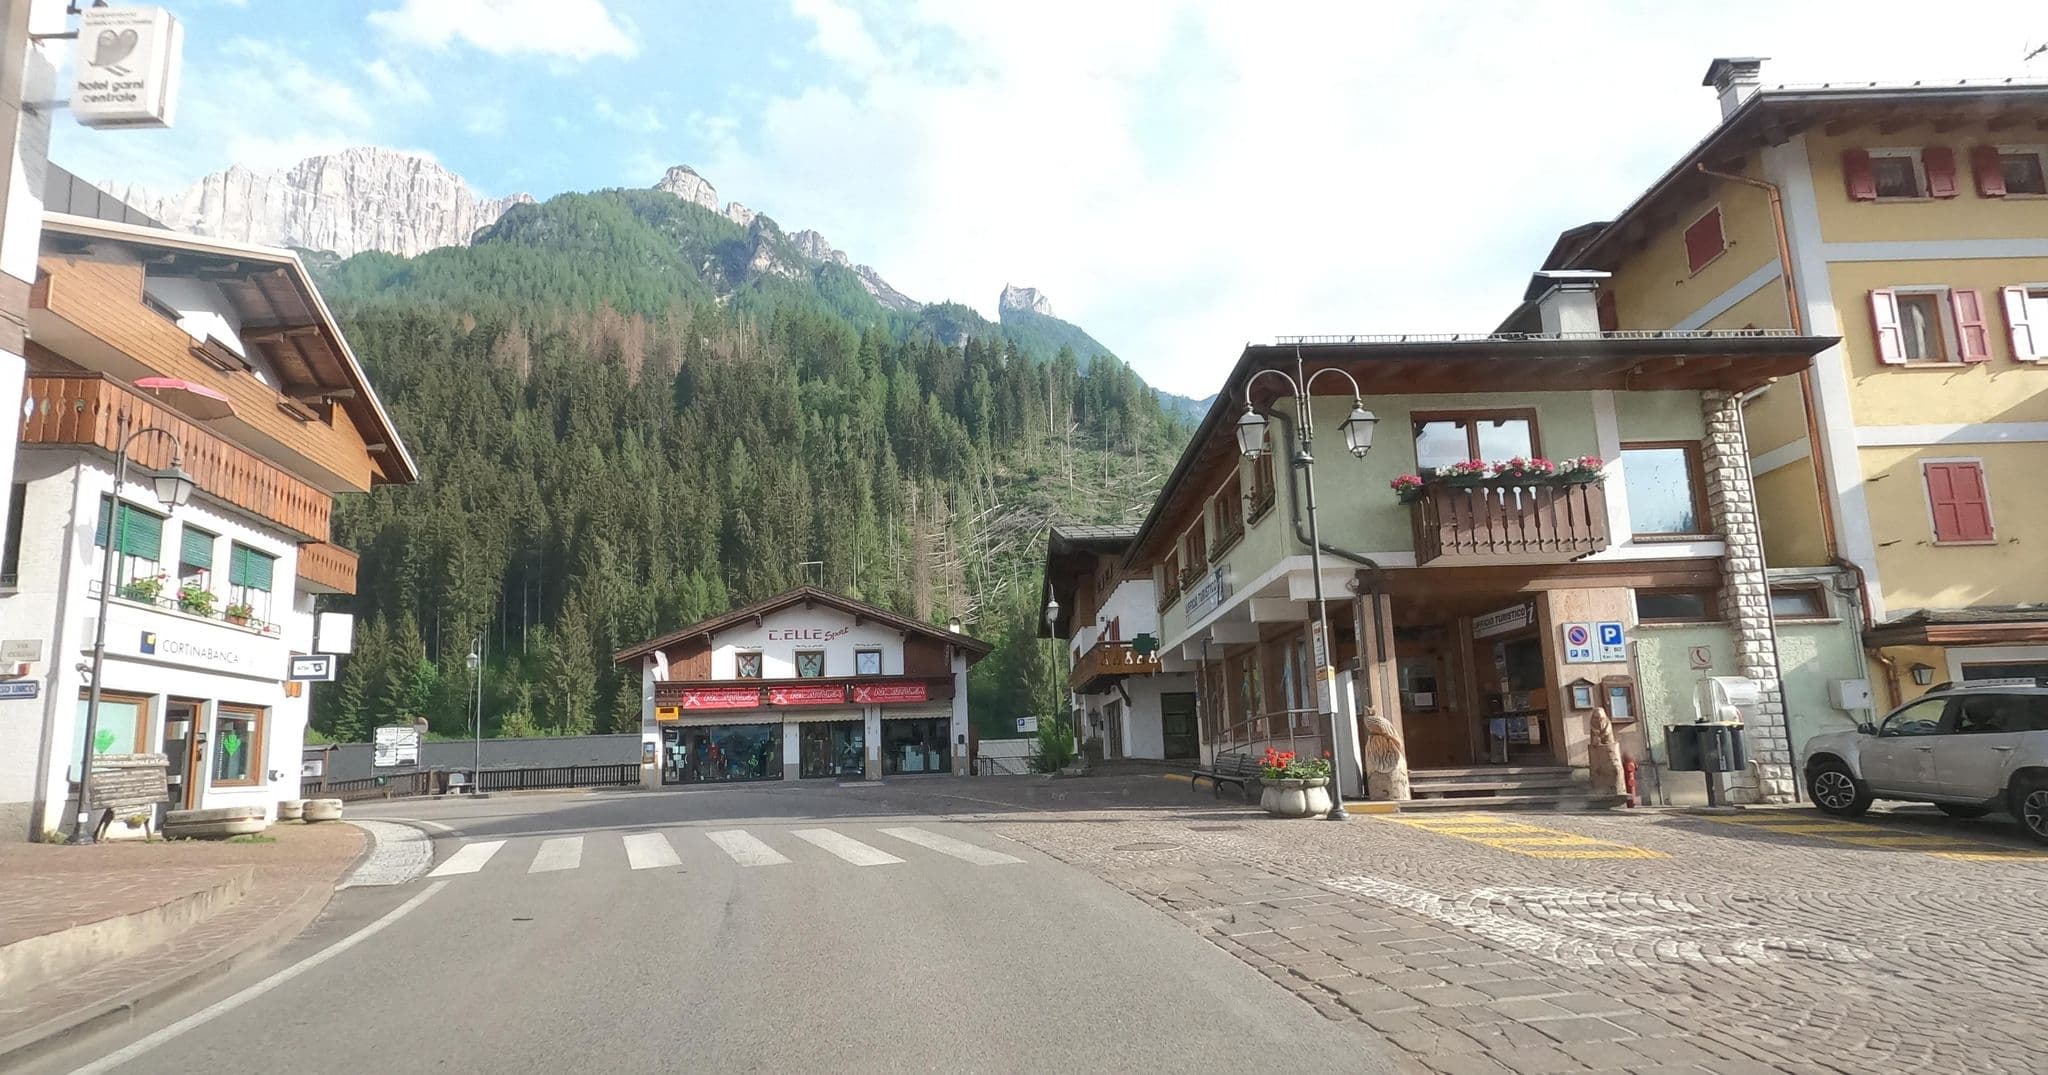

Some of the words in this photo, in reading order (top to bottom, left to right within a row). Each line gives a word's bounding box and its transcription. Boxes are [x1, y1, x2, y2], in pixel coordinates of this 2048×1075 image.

[78, 80, 108, 91] hotel
[111, 80, 144, 92] garni
[82, 93, 137, 103] centrale
[1495, 608, 1526, 625] TURISTICO
[1604, 627, 1617, 643] P
[162, 639, 240, 664] CORTINABANCA
